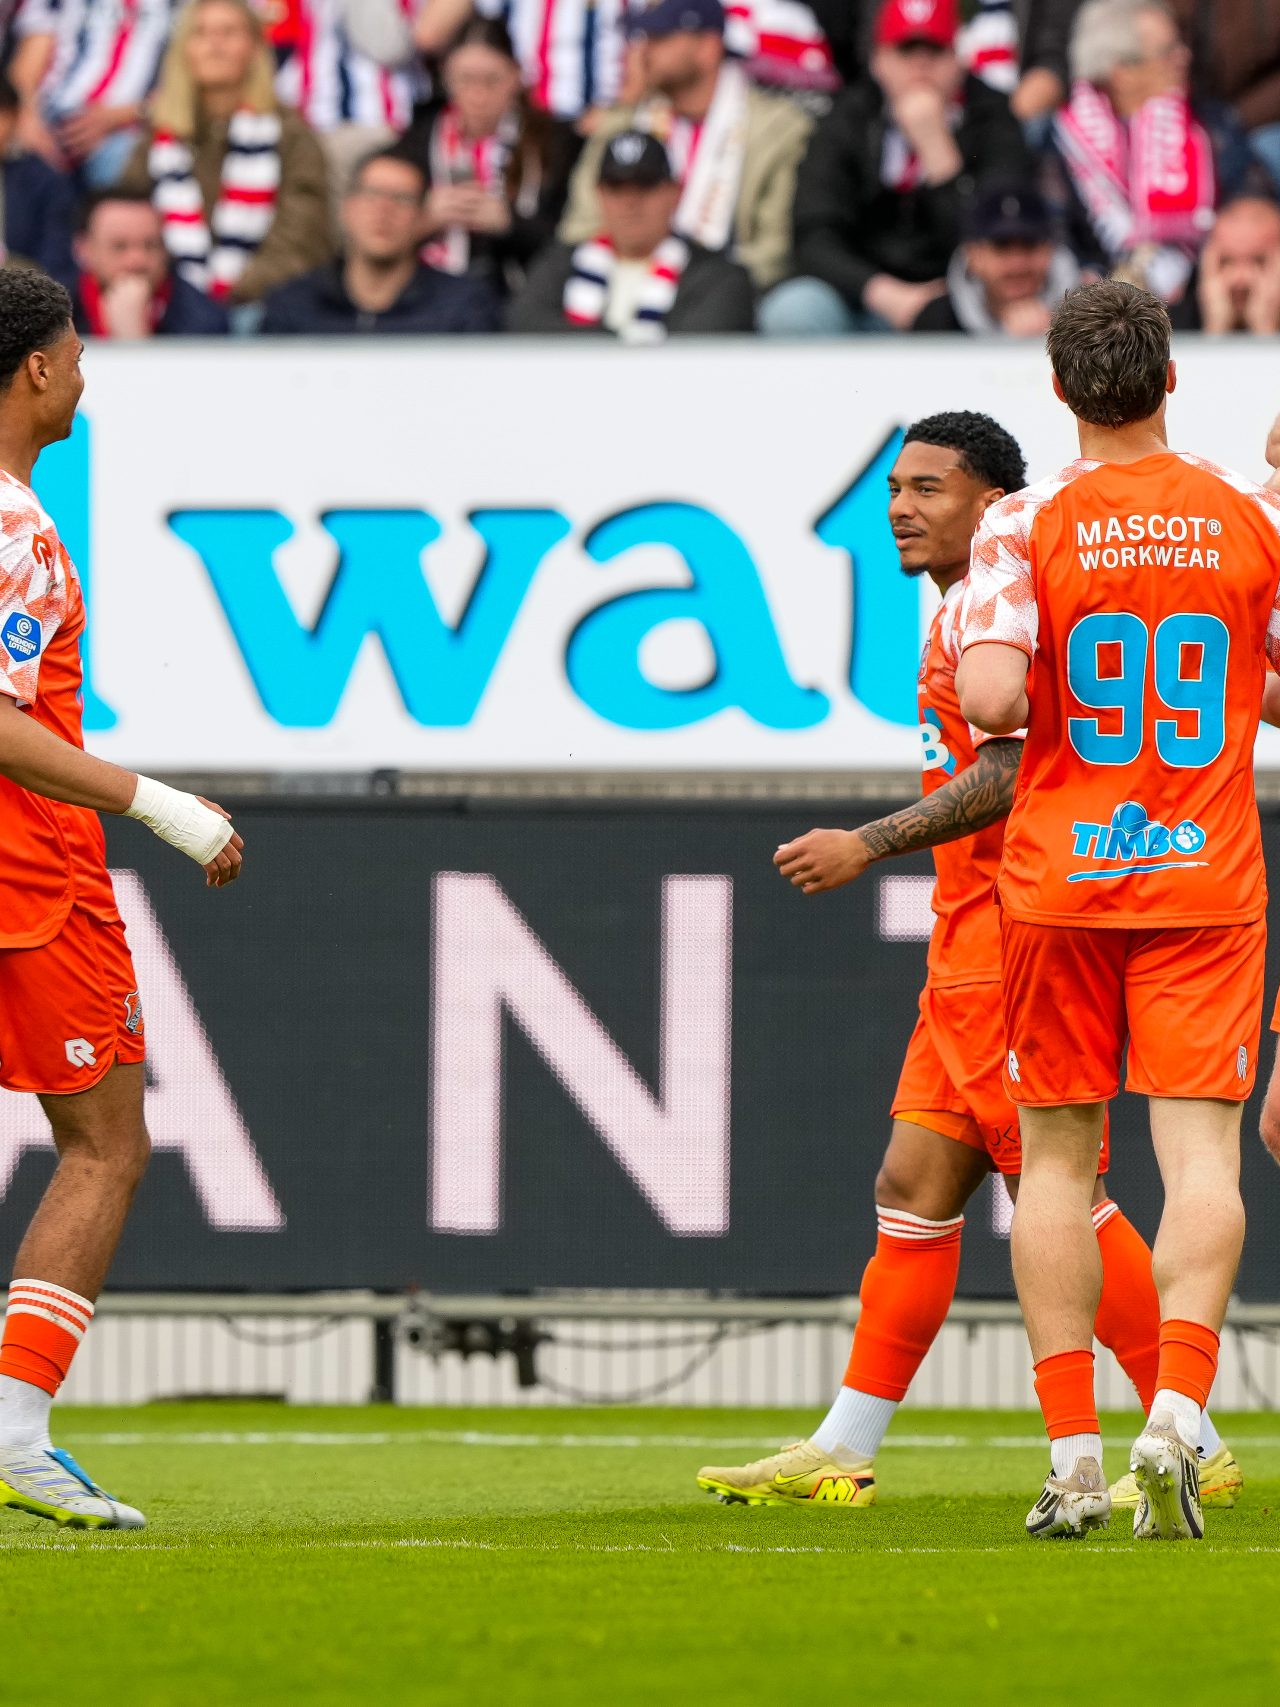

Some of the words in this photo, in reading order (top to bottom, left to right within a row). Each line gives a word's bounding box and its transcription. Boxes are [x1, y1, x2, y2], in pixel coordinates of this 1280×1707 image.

[167, 428, 922, 731] wat
[1078, 544, 1220, 571] WORKWEAR
[1067, 612, 1230, 768] 99
